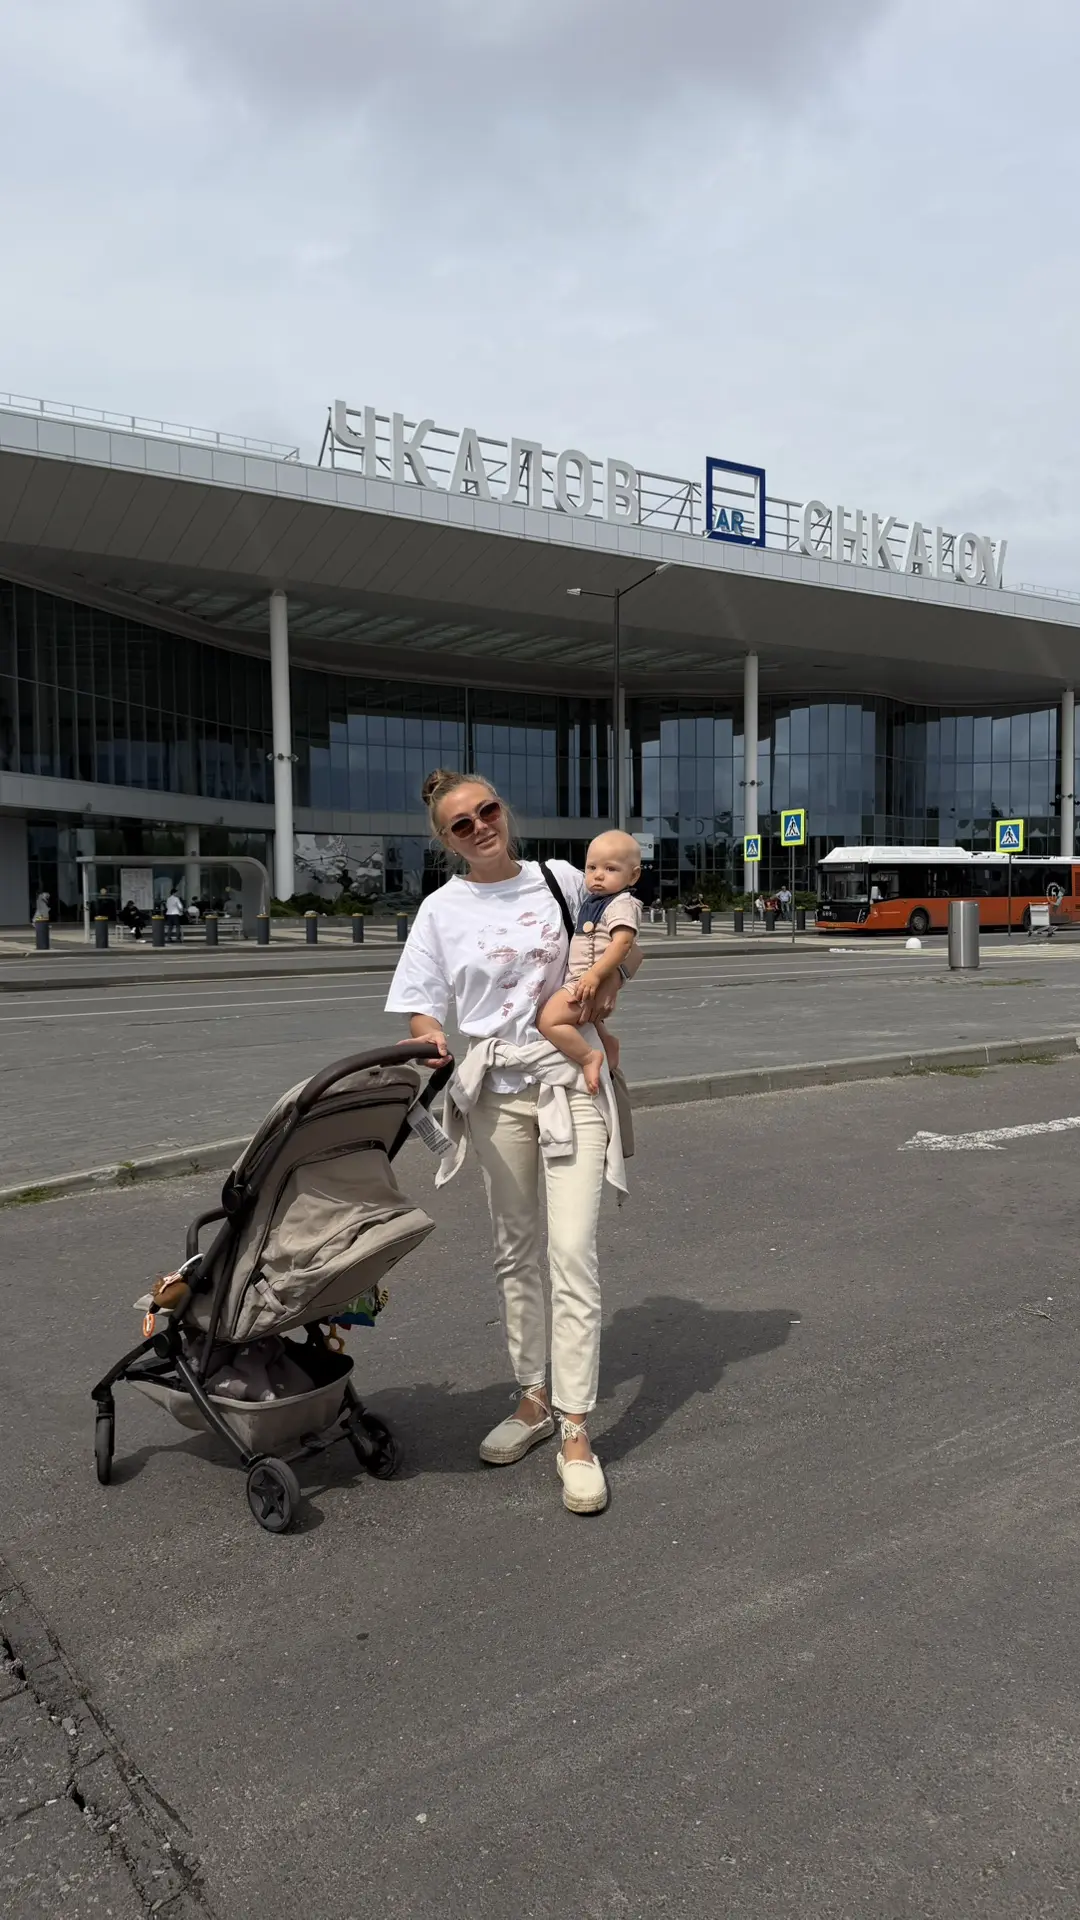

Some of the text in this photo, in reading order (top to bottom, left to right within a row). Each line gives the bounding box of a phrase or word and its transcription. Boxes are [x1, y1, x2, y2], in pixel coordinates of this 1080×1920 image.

[333, 400, 640, 525] ЧКАЛОВ
[715, 508, 744, 535] AR
[800, 500, 1008, 590] CHKALOV
